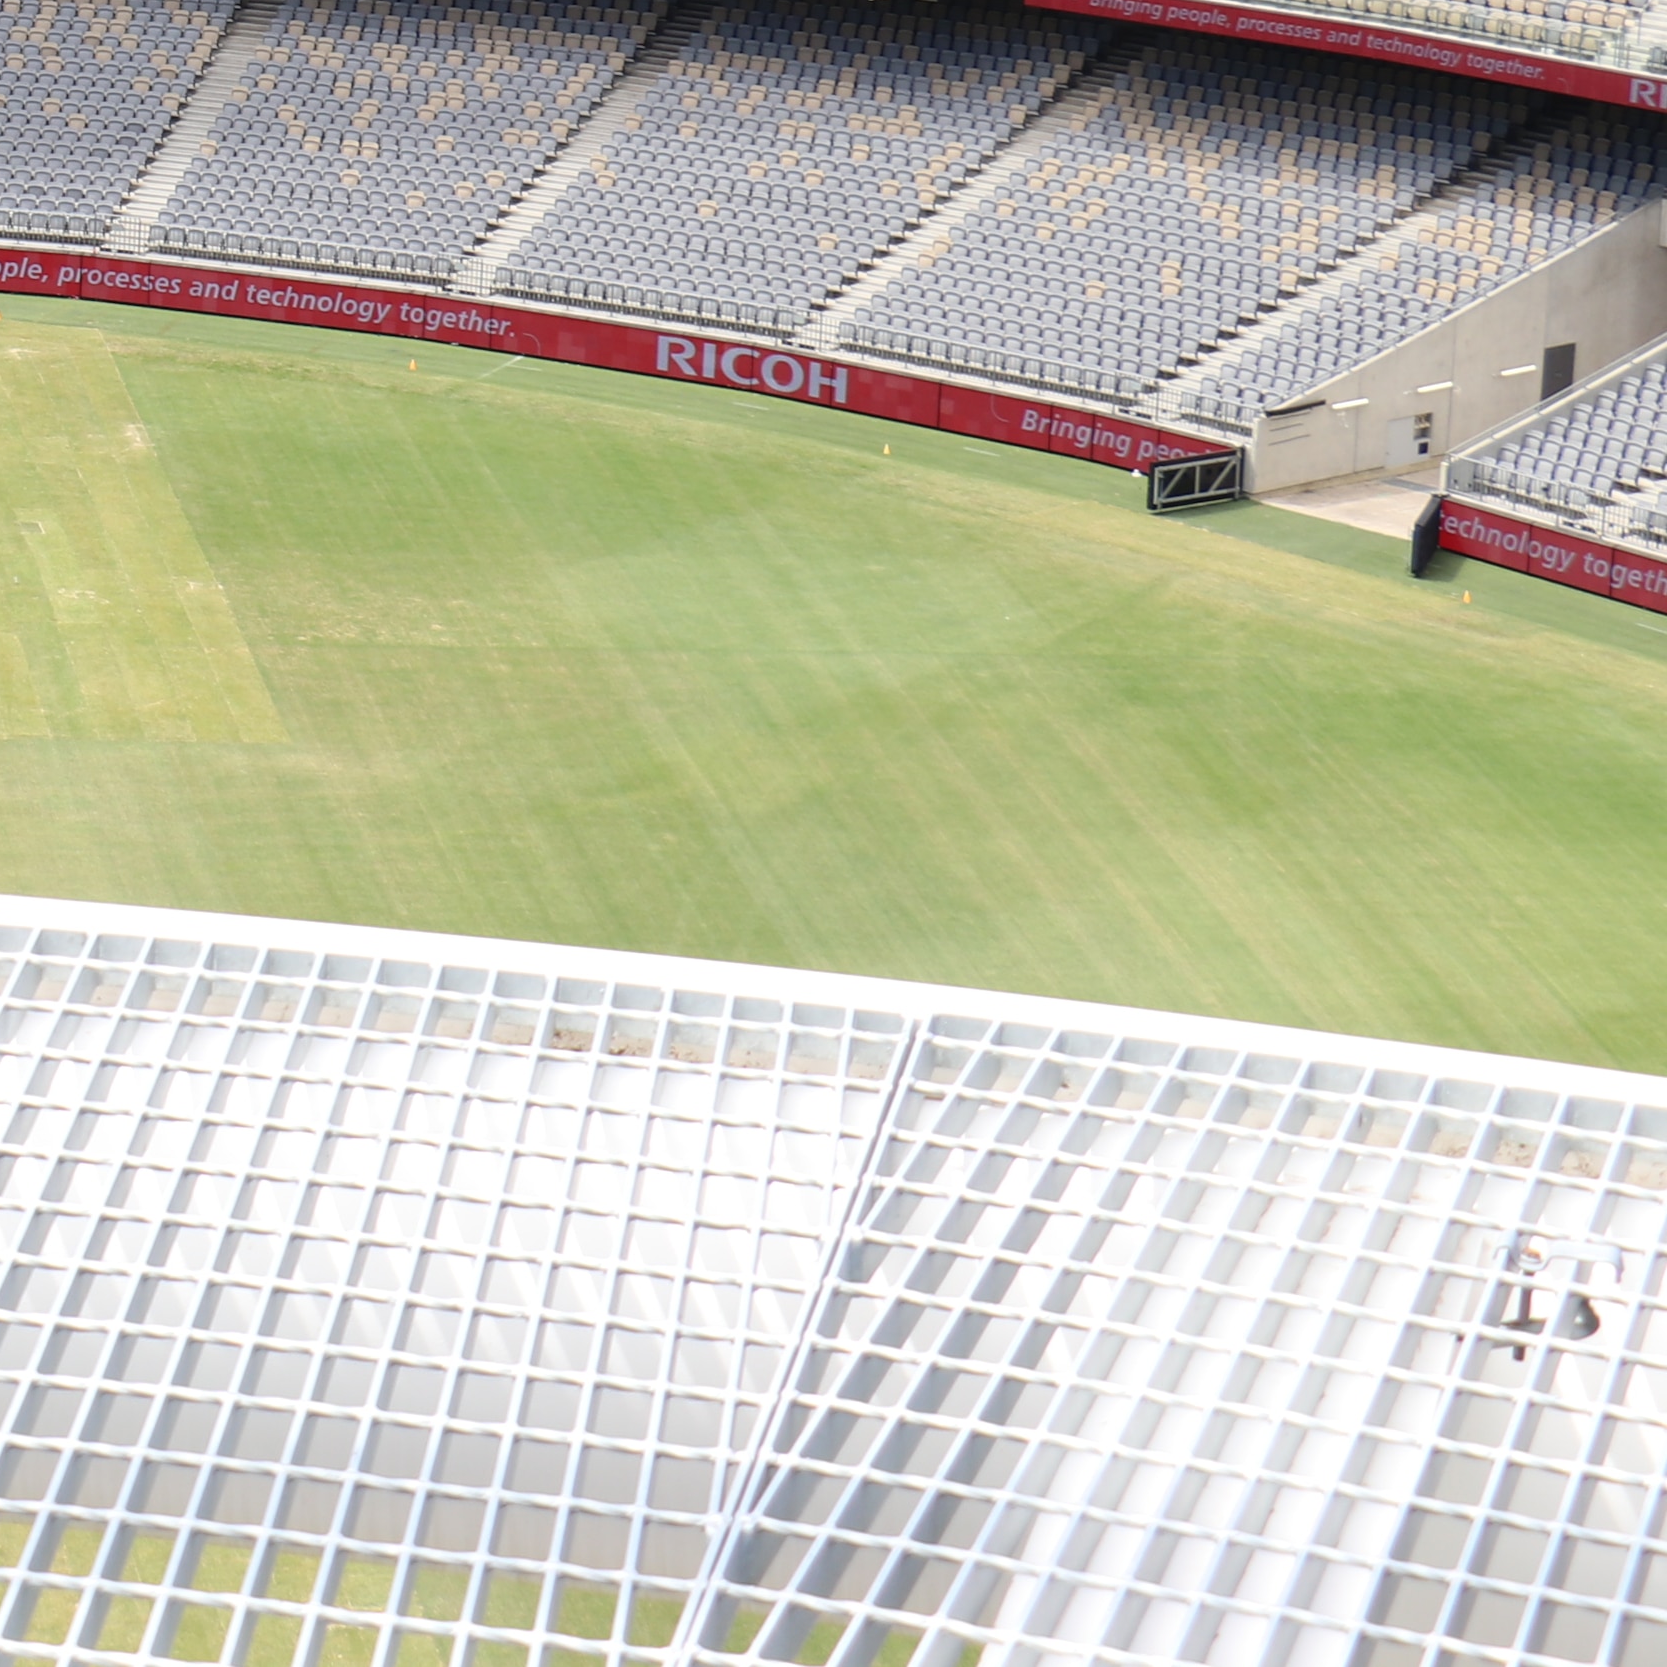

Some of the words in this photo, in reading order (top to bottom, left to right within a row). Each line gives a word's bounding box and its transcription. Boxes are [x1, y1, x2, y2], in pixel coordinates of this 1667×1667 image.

[1166, 3, 1232, 31] people,
[1236, 15, 1322, 40] processes
[1326, 28, 1363, 46] and
[1366, 31, 1465, 69] technology
[1468, 50, 1547, 81] together.
[57, 267, 182, 294] processes
[189, 280, 240, 300] and
[247, 285, 393, 324] technology
[400, 303, 517, 339] together.
[656, 335, 849, 404] RICOH
[1020, 409, 1133, 452] Bringing
